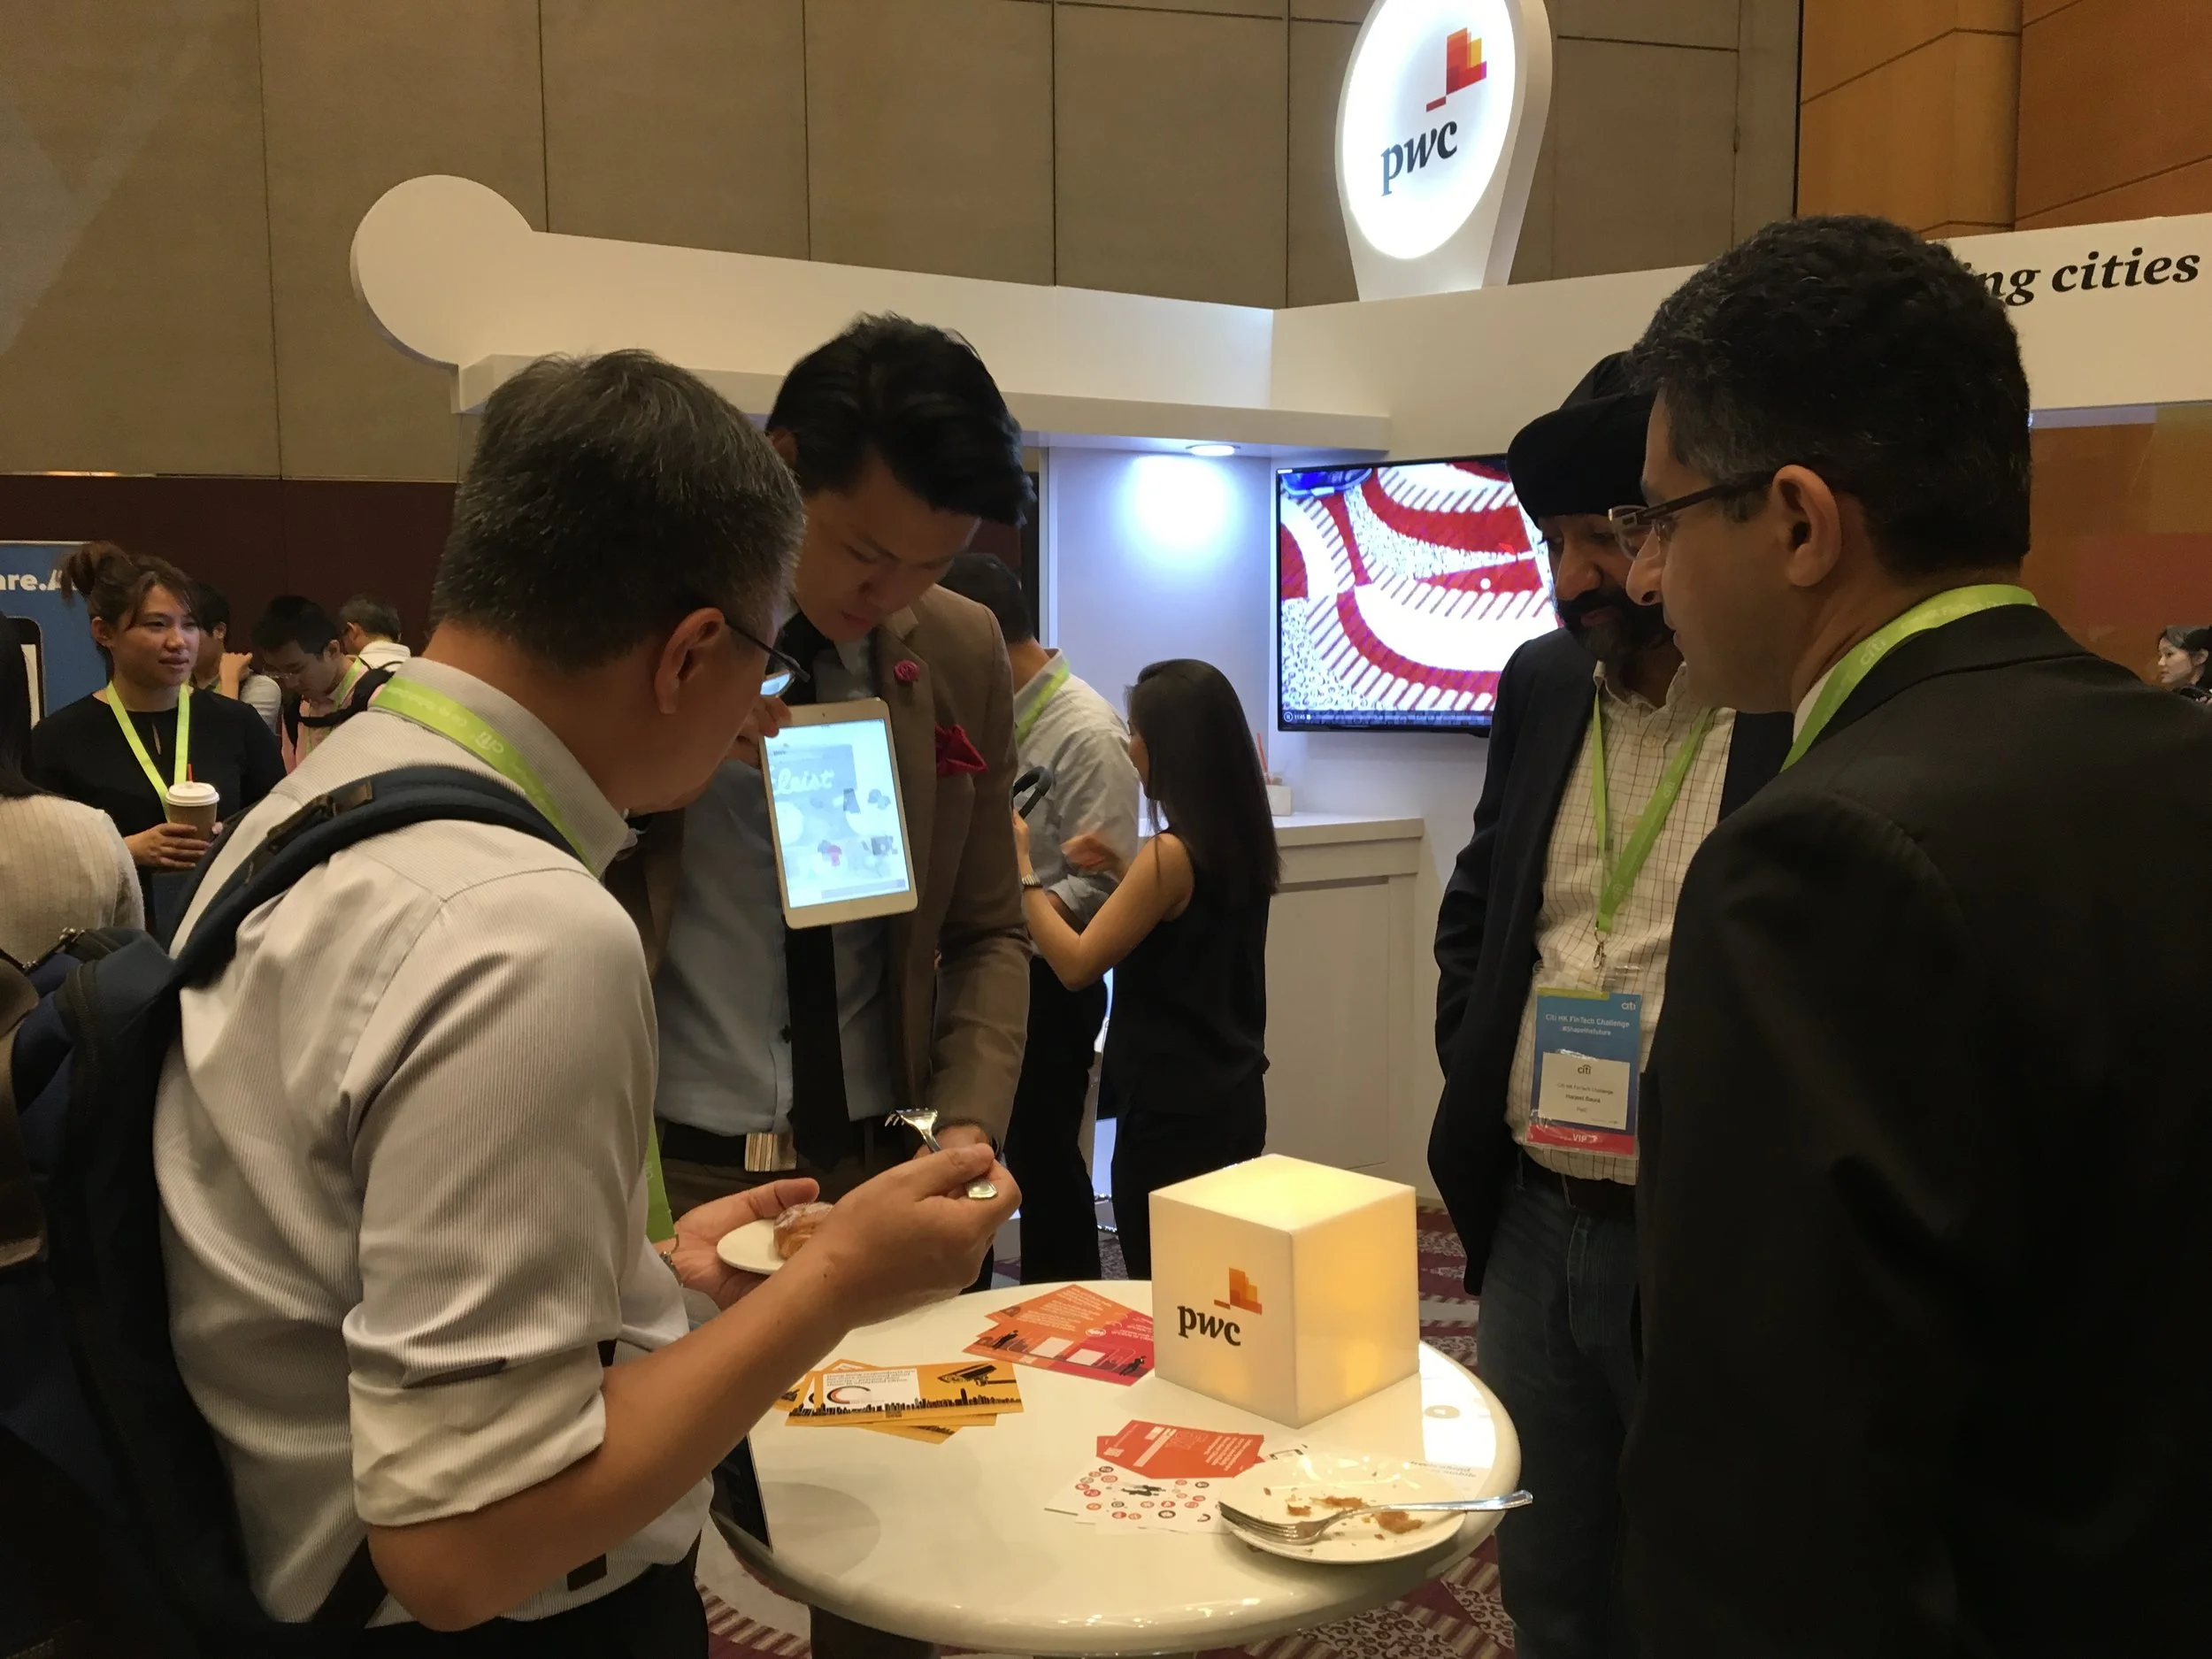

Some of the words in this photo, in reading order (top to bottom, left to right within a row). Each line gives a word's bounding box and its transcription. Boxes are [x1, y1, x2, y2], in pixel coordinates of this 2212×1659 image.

[1380, 120, 1457, 196] pwc
[1963, 262, 2040, 306] ng
[2052, 247, 2200, 292] cities
[1621, 1001, 1637, 1011] citi
[1596, 1018, 1630, 1029] Challenge
[1577, 1064, 1592, 1074] citi
[1177, 1304, 1241, 1347] pwc
